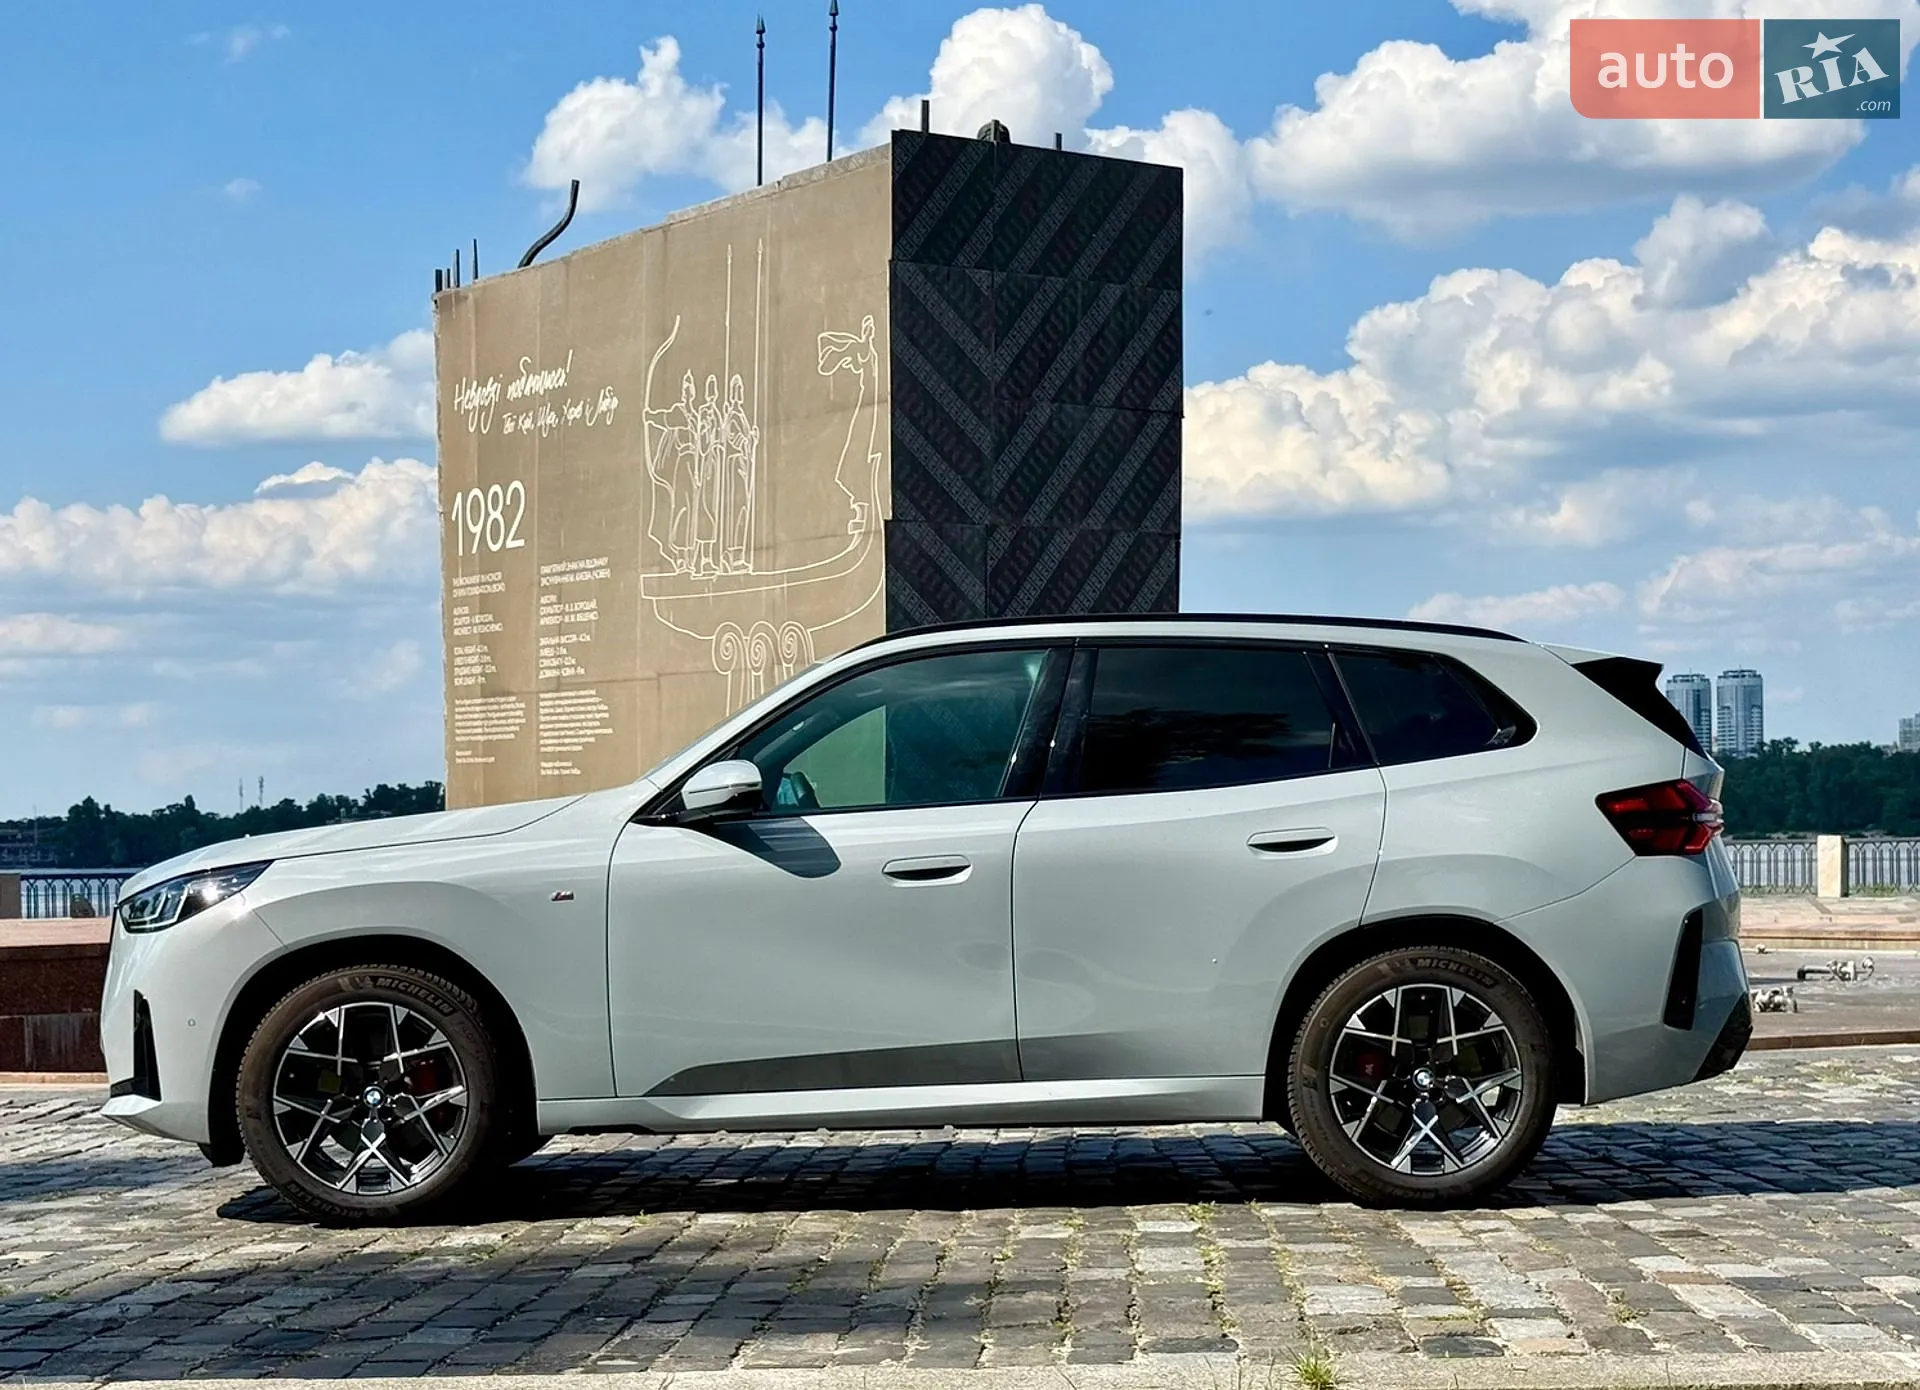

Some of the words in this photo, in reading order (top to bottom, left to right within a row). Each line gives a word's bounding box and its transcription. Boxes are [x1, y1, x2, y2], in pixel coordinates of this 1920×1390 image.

[452, 480, 526, 557] 1982
[1417, 958, 1496, 987] MICHELIN
[376, 977, 454, 1014] MICHELIN
